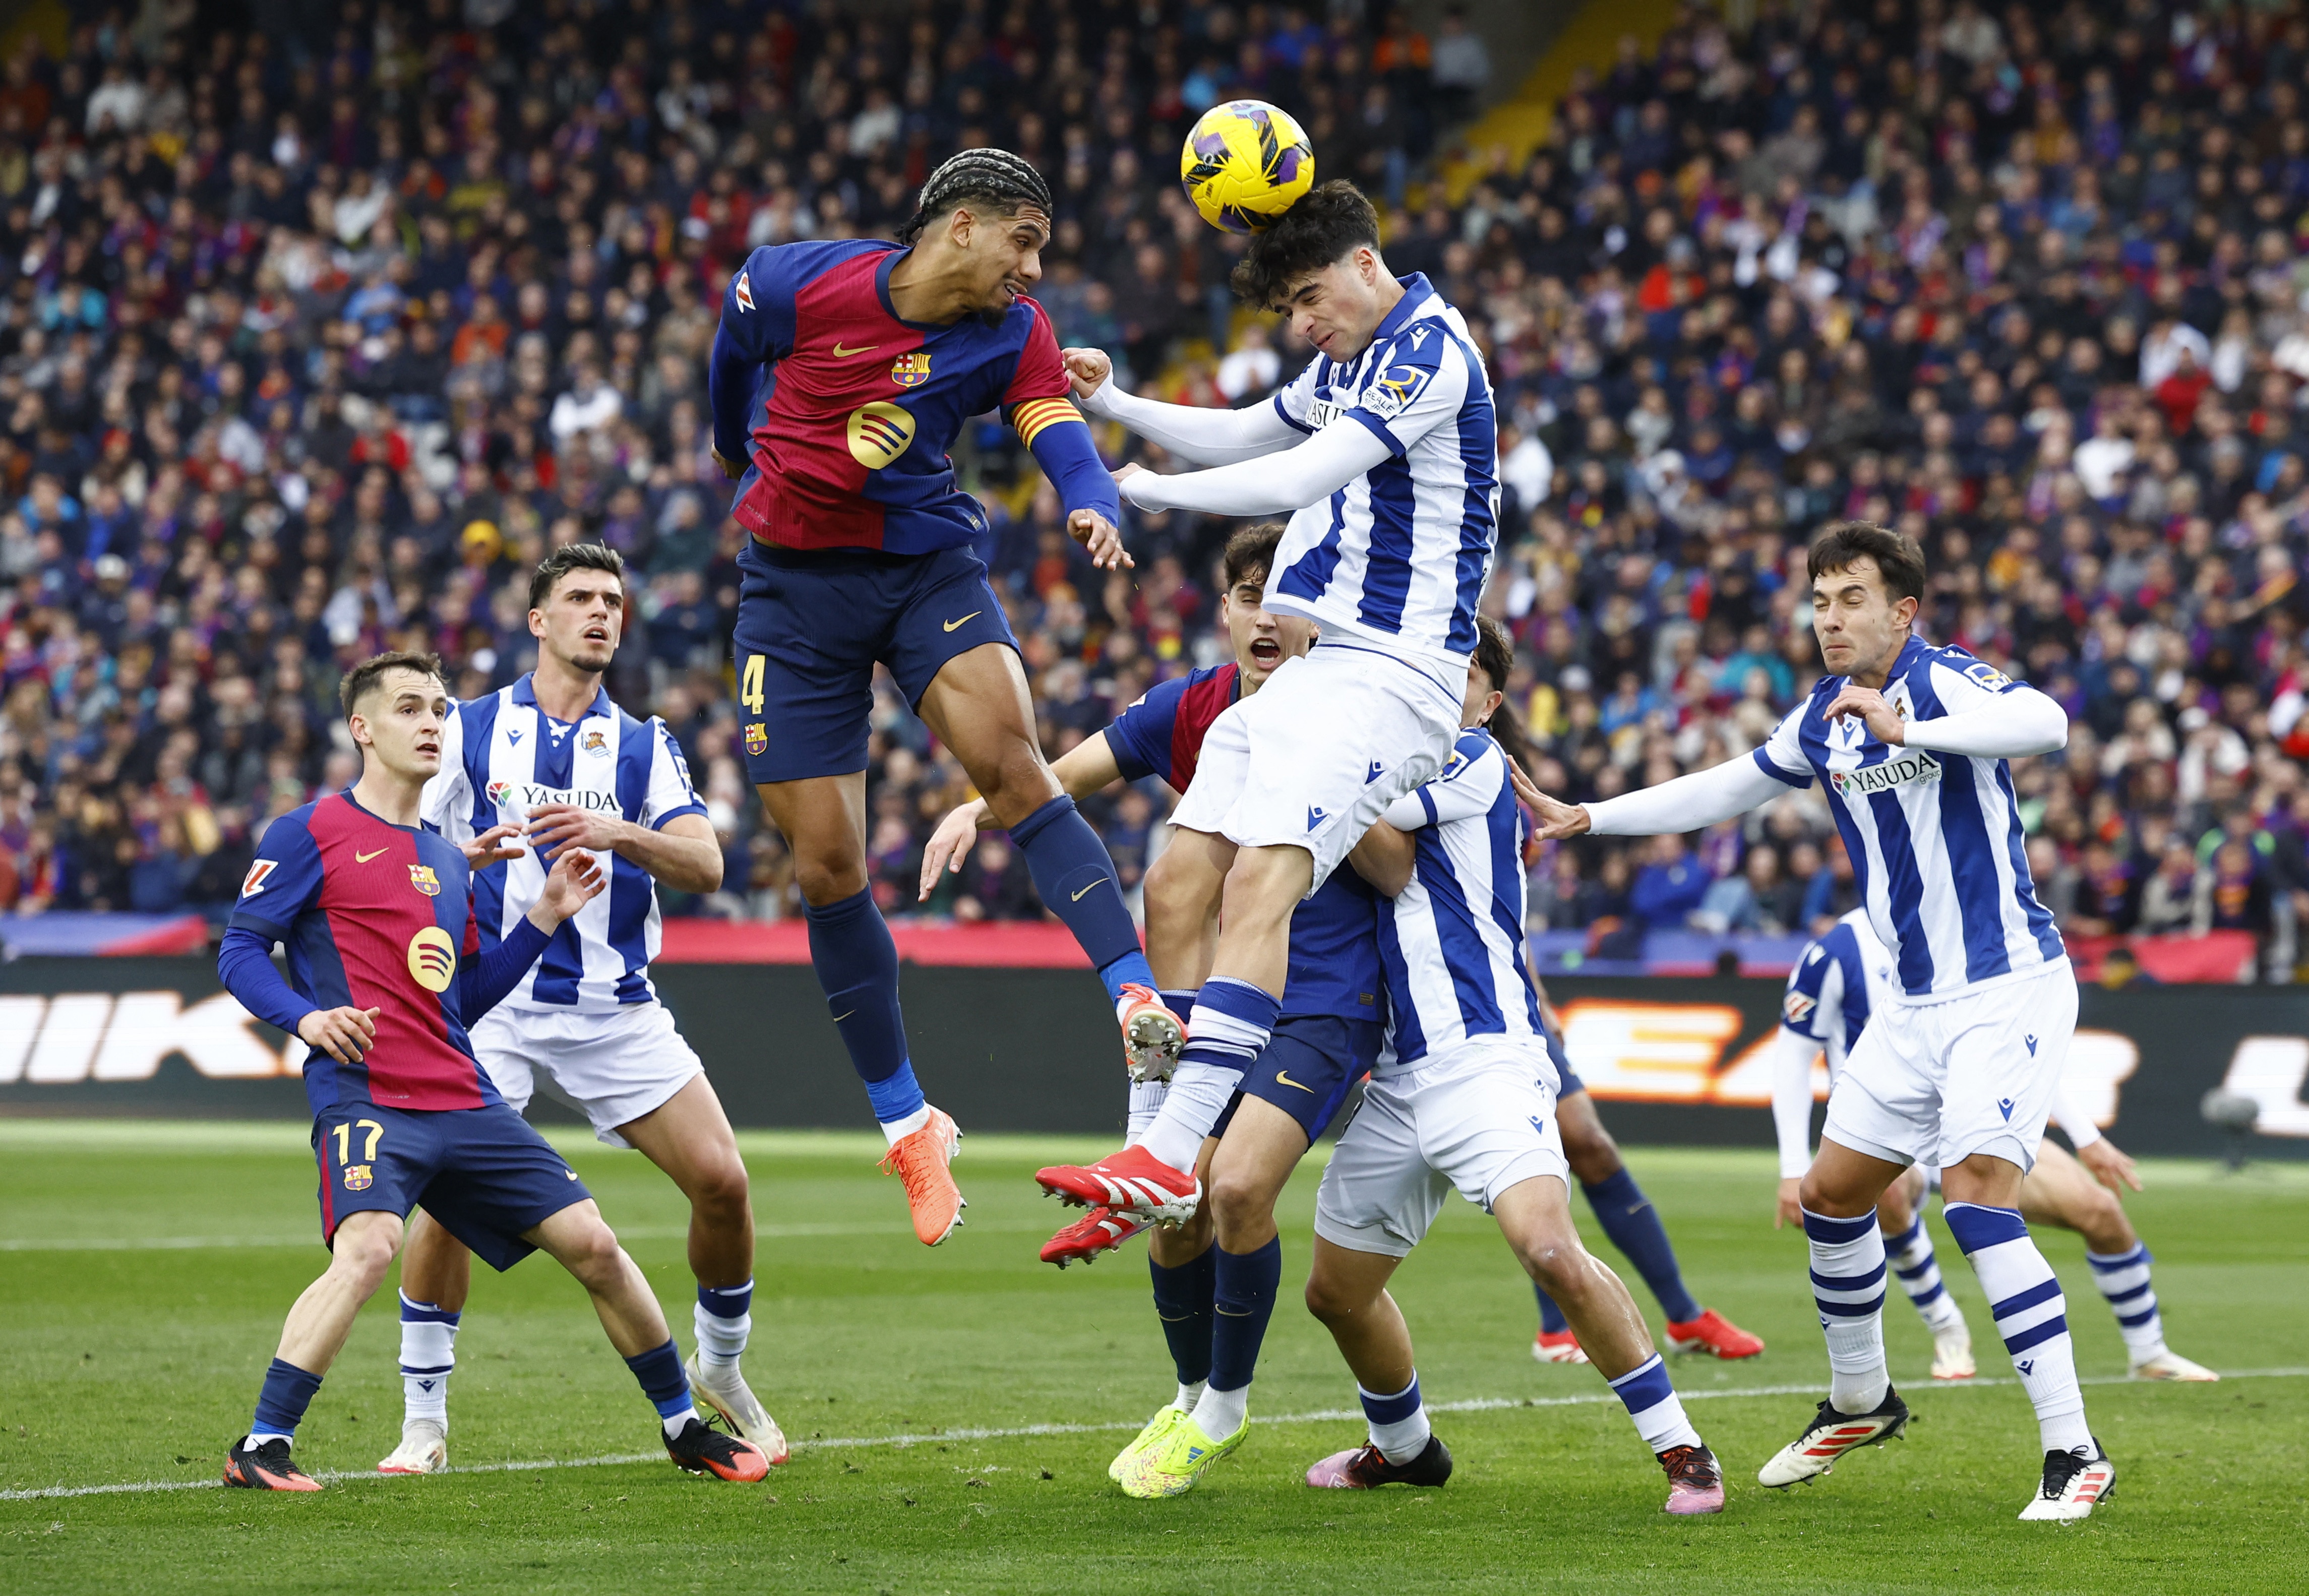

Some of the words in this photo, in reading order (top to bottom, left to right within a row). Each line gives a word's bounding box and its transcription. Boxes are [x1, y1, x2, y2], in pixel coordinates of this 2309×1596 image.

[1365, 390, 1395, 414] REALE
[742, 654, 766, 715] 4
[1850, 753, 1938, 792] YASUDA
[1919, 770, 1941, 785] group
[522, 786, 620, 811] YASUDA
[332, 1119, 385, 1167] 17
